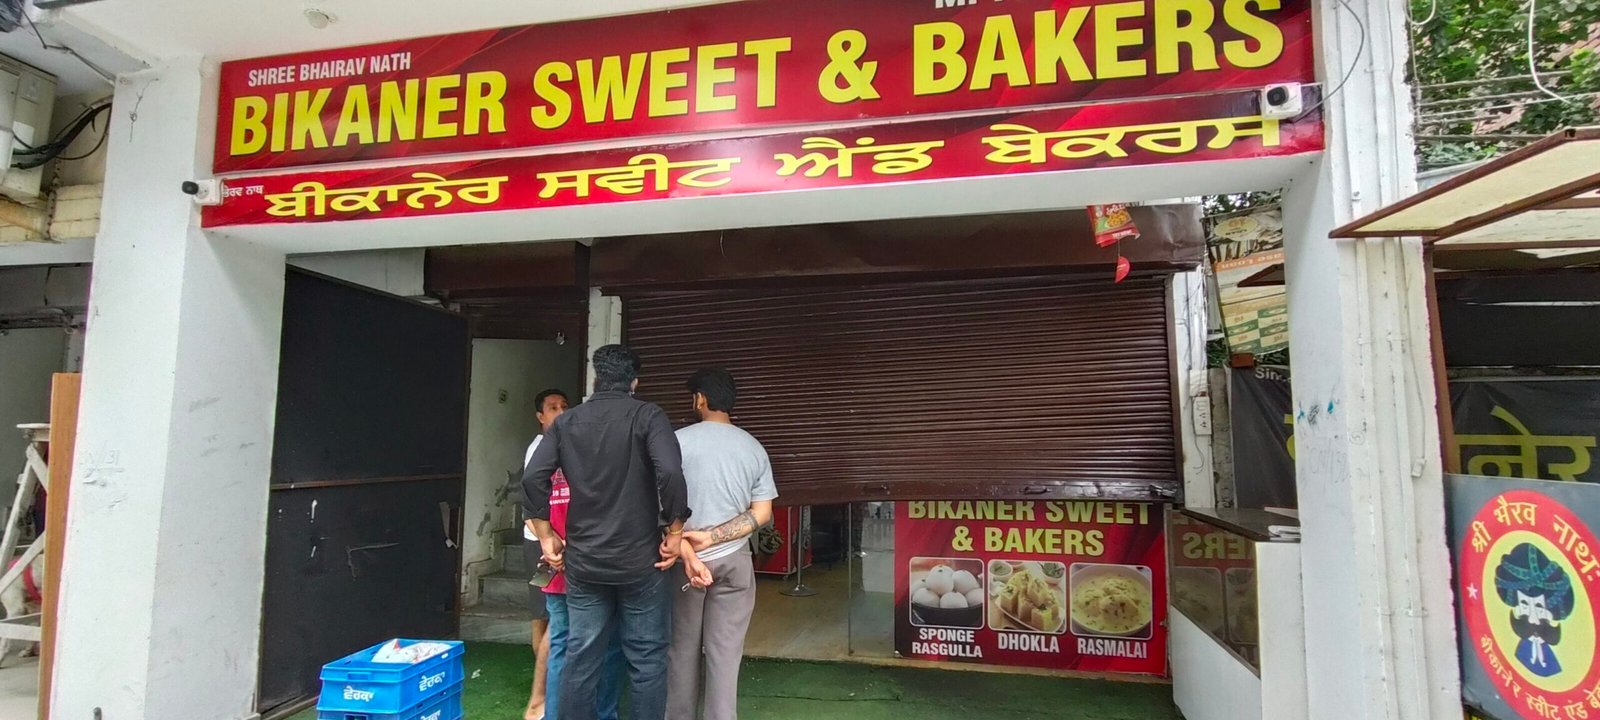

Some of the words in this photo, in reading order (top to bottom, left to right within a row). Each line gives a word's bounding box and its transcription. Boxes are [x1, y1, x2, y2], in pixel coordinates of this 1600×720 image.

[229, 69, 507, 157] BIKANER
[530, 36, 792, 131] SWEET
[817, 29, 881, 104] &
[912, 0, 1285, 96] BAKERS
[248, 65, 297, 87] SHREE
[299, 58, 367, 81] BHAIRAV
[368, 52, 412, 75] NATH
[264, 171, 508, 218] ਬੀਕਾਨੇਰ
[537, 152, 741, 200] ਸਵੀਟ
[773, 136, 945, 178] ਐਂਡ
[981, 115, 1281, 164] ਬੇਕਰਸ
[908, 500, 1038, 523] BIKANER
[1045, 501, 1153, 526] SWEET
[1470, 520, 1492, 553] श्री
[1493, 495, 1538, 527] भैरव
[951, 525, 975, 552] &
[983, 526, 1105, 557] BAKERS
[912, 641, 983, 659] RASGULLA
[919, 627, 976, 644] SPONGE
[997, 632, 1060, 655] DHOKLA
[1077, 637, 1148, 660] RASMALAI
